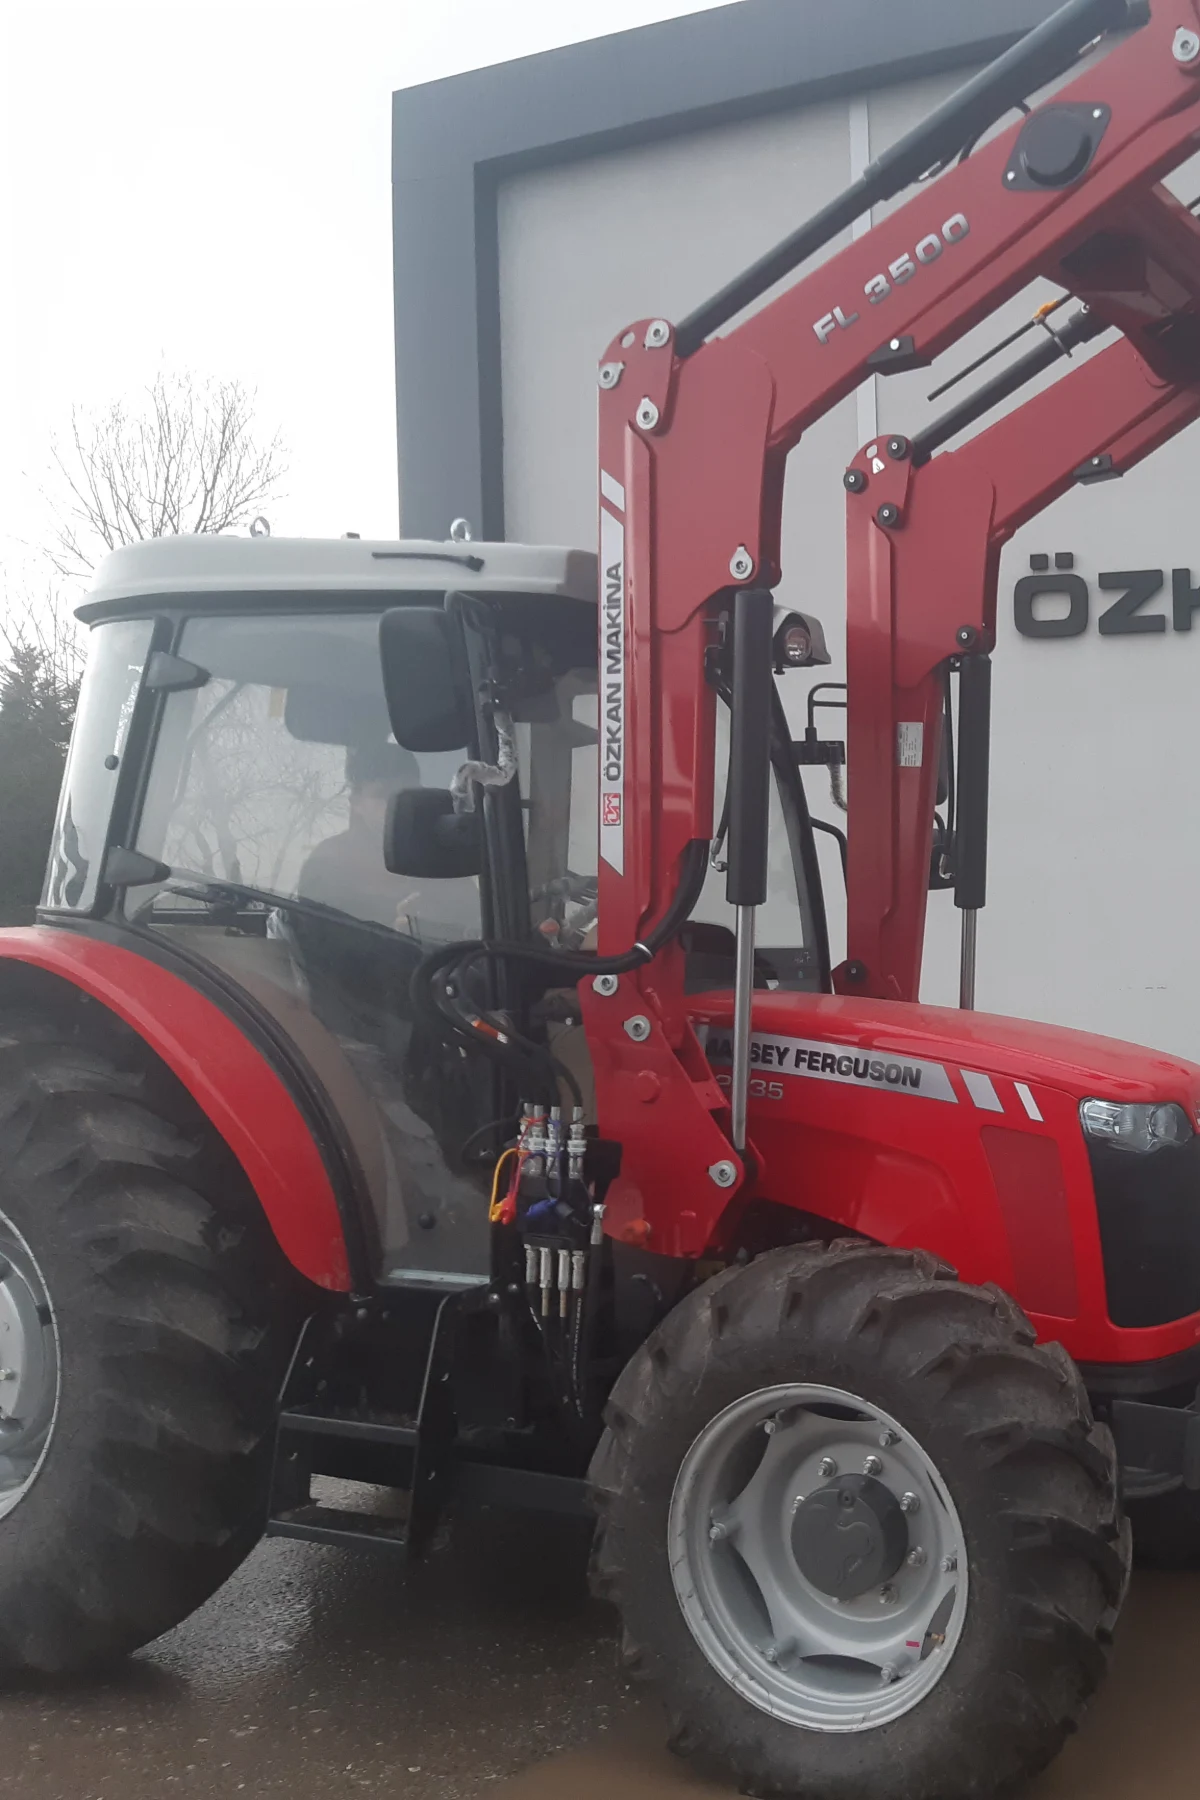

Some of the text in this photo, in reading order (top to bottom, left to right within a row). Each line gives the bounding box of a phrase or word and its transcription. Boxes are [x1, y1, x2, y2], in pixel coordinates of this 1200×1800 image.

[812, 212, 970, 345] FL 3500
[602, 563, 622, 674] MAKİNA
[602, 682, 622, 781] ÖZKAN
[705, 1037, 923, 1089] MASEY FERGUSON
[715, 1074, 784, 1100] 235
